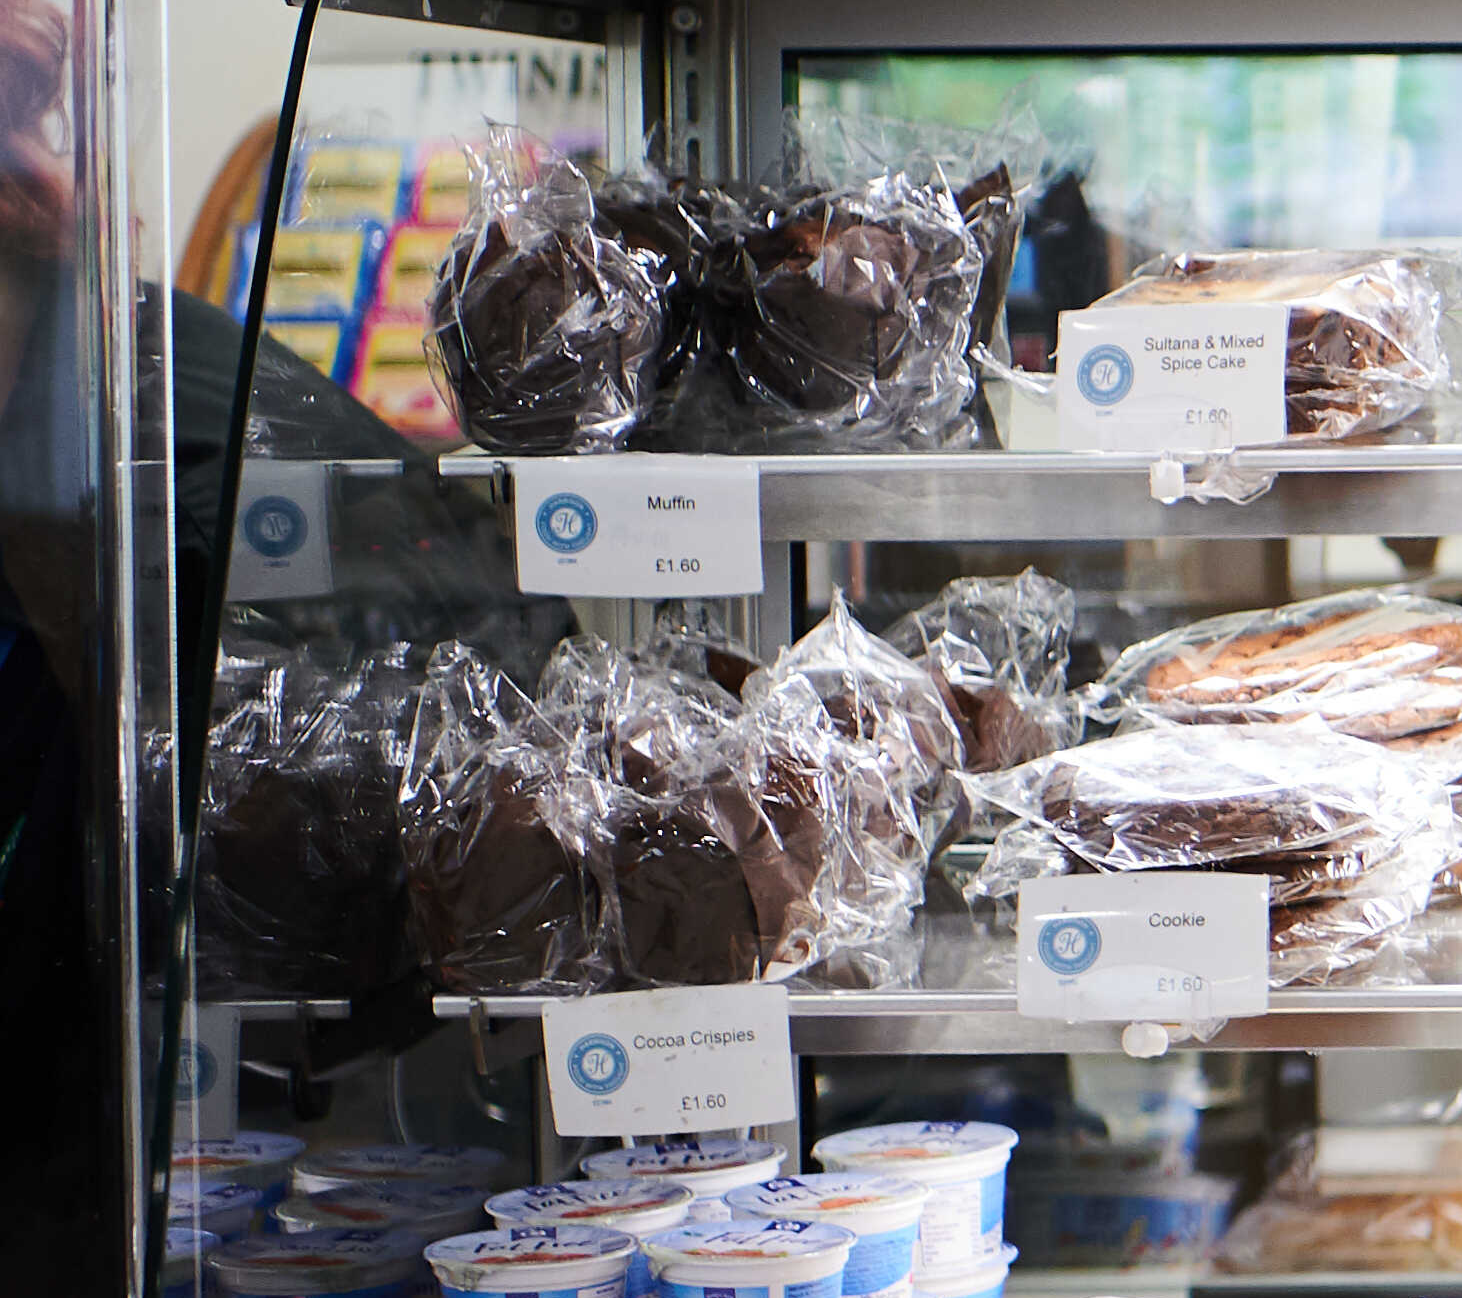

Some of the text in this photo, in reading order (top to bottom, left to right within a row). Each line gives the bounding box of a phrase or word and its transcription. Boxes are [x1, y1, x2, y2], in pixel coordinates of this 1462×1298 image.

[1144, 335, 1264, 351] Sultana & Mixed
[1161, 355, 1246, 373] Spice Cake
[1186, 408, 1228, 427] £1.60
[648, 496, 695, 510] Muffin
[656, 559, 700, 572] £1.60
[1149, 913, 1205, 927] Cookie
[1158, 975, 1204, 991] £1.60
[634, 1031, 755, 1050] Cocoa Crispies
[682, 1094, 726, 1110] £1.60
